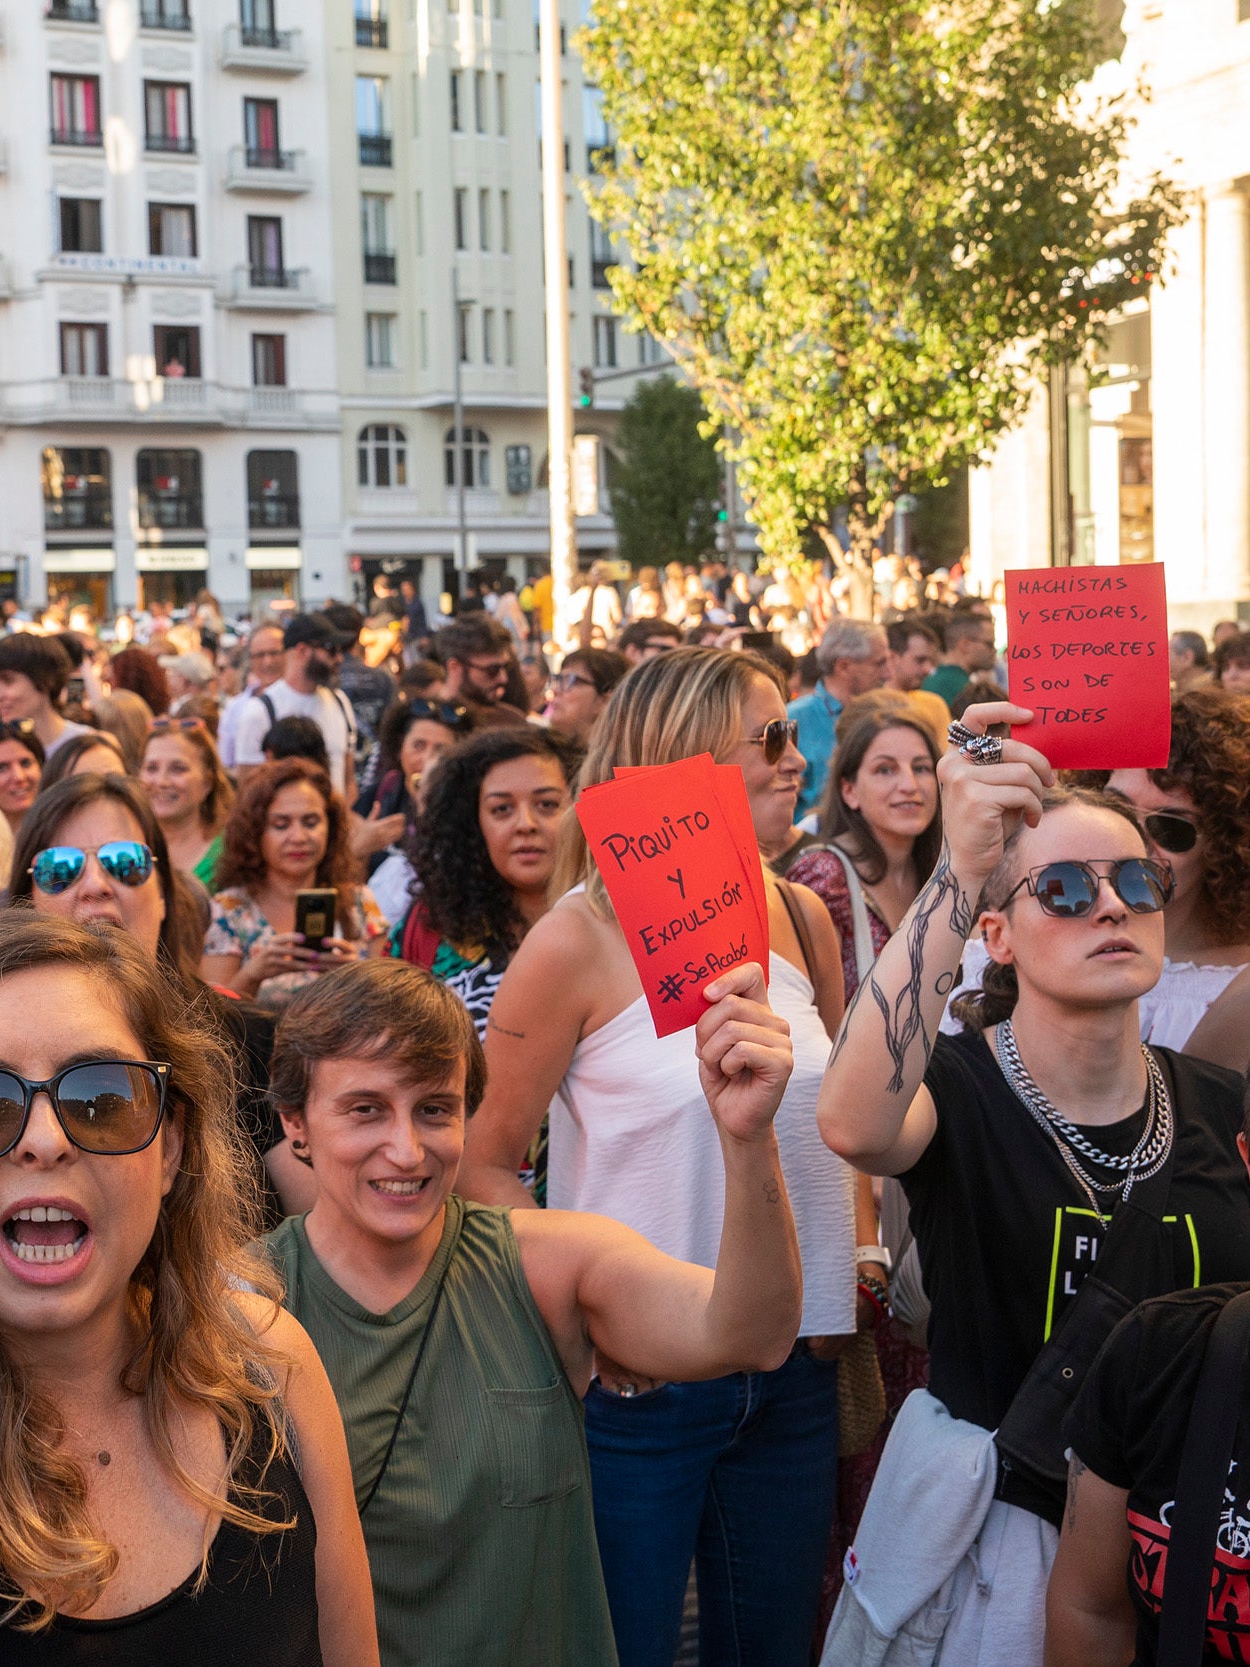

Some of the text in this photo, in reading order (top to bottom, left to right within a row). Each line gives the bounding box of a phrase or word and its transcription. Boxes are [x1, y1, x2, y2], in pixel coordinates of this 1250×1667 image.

[1019, 605, 1149, 624] Y SEÑORES,
[1011, 641, 1156, 660] LOS DEPORTES
[1023, 674, 1115, 692] SON DE
[1036, 706, 1108, 725] TODES
[666, 868, 686, 899] Y
